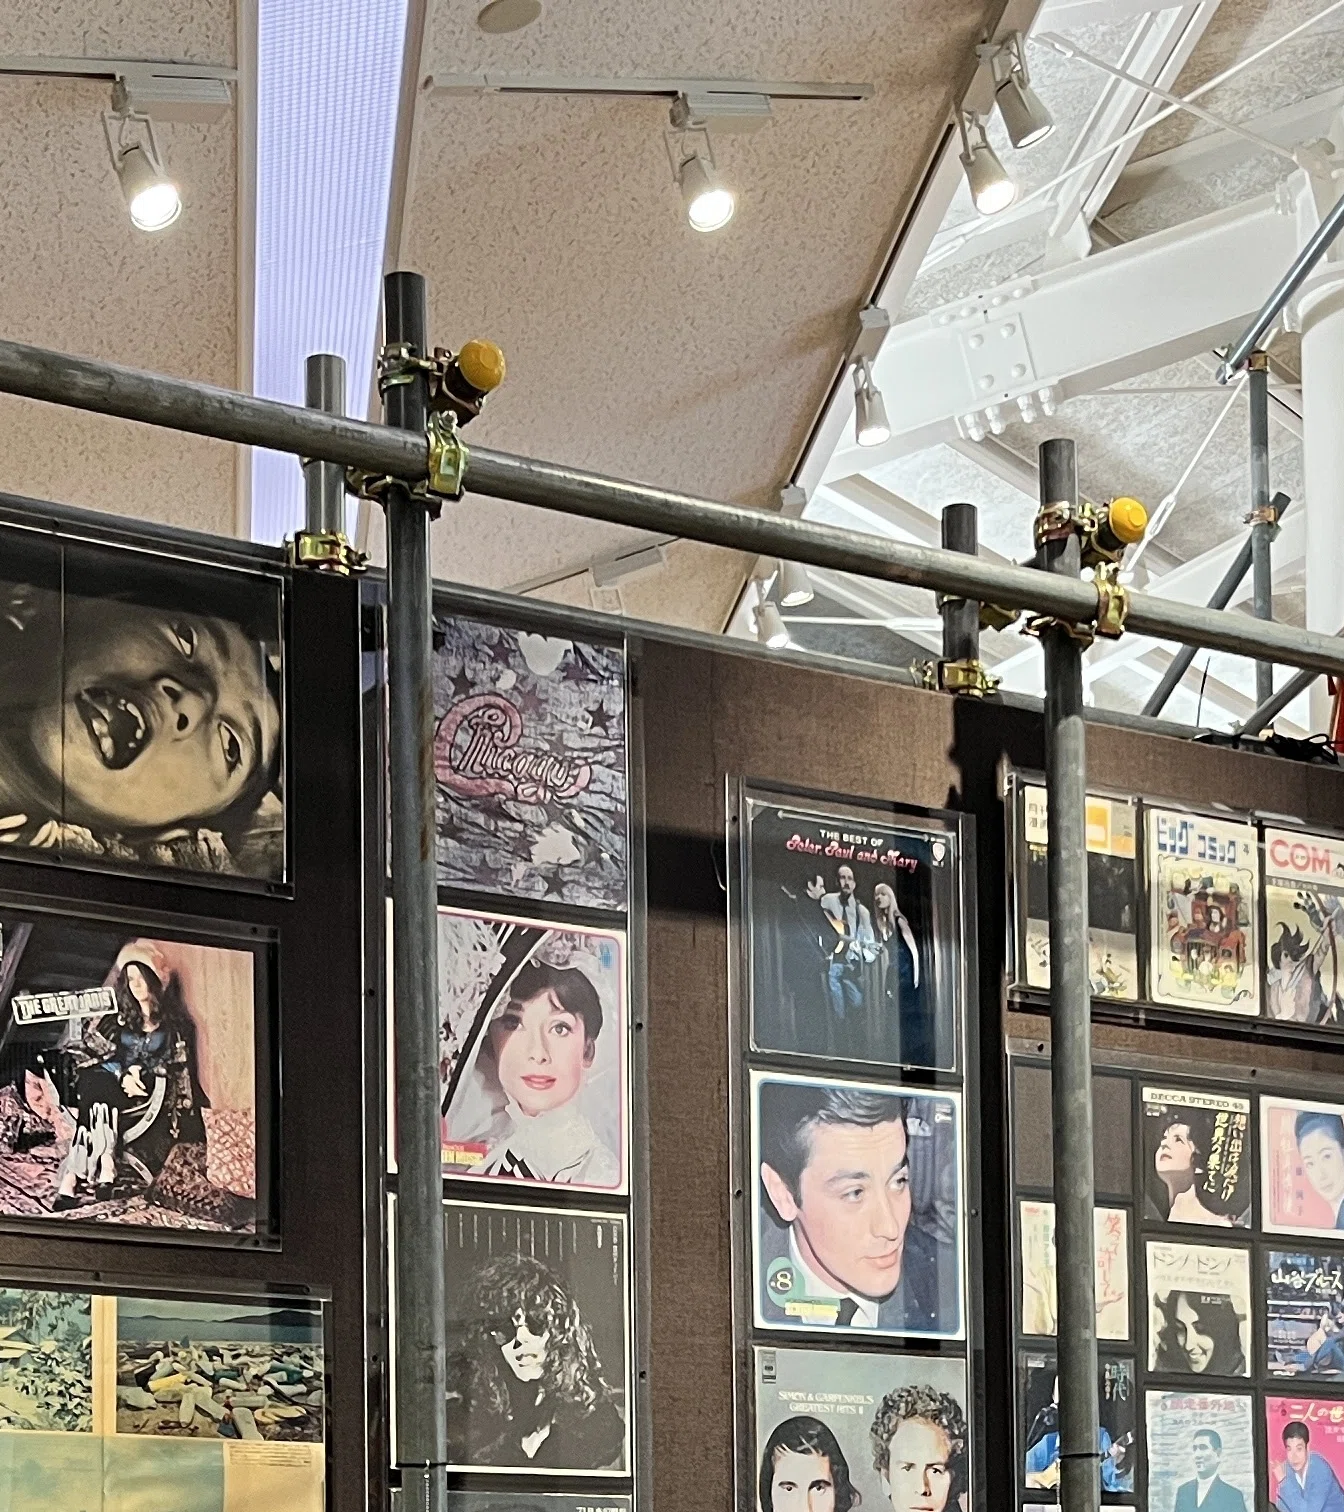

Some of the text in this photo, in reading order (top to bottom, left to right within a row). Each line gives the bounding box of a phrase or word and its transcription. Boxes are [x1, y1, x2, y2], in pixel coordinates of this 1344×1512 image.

[819, 829, 884, 848] THE BEST OF
[1269, 838, 1332, 876] COM
[1150, 1092, 1187, 1103] DECCA
